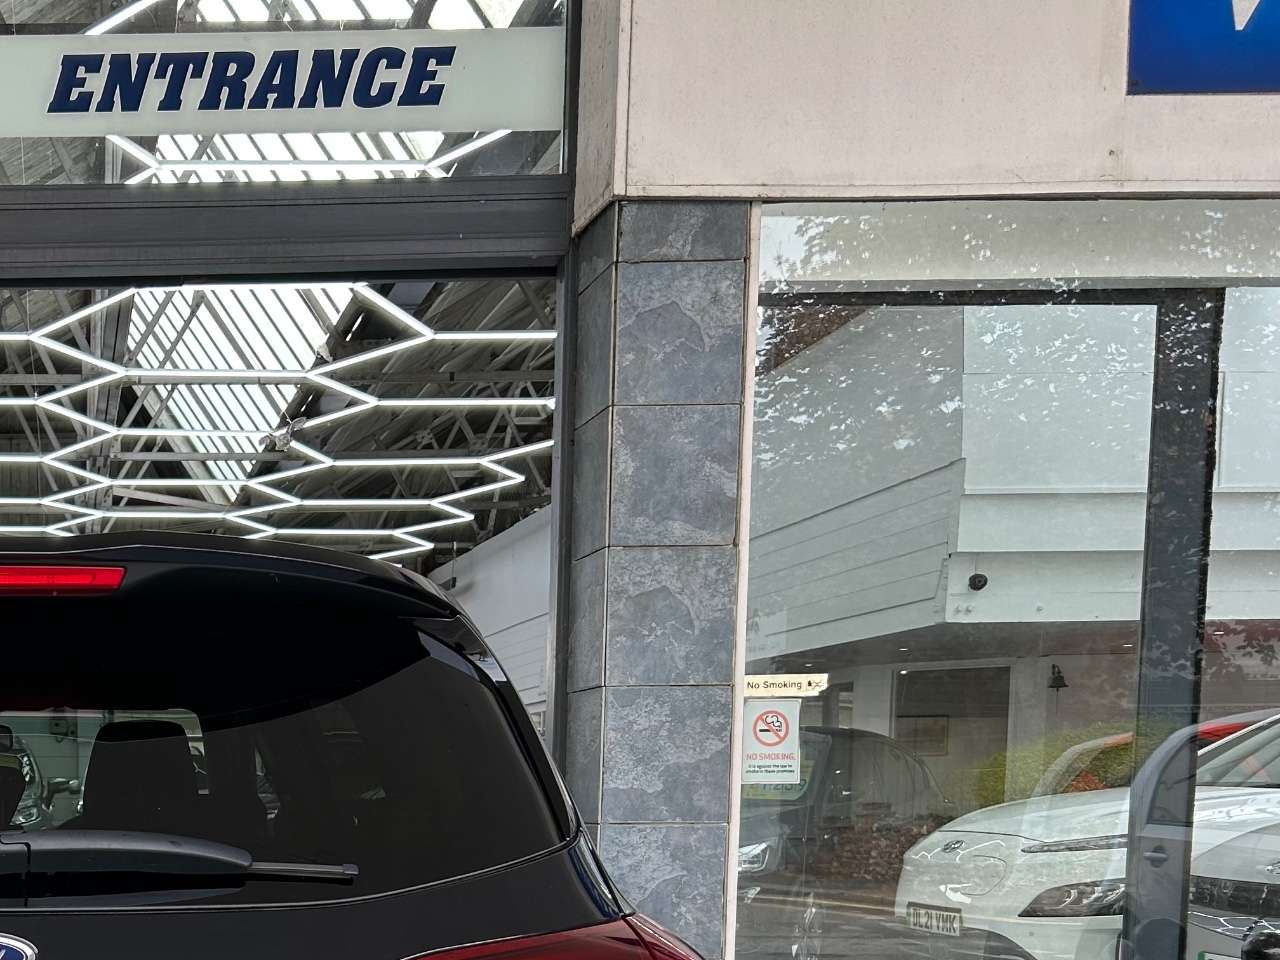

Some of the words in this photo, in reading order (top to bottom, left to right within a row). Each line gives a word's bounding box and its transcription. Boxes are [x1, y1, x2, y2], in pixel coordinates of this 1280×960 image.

[47, 45, 457, 114] ENTRANCE
[746, 681, 760, 689] No
[763, 681, 802, 690] Smoking
[746, 752, 758, 761] NO
